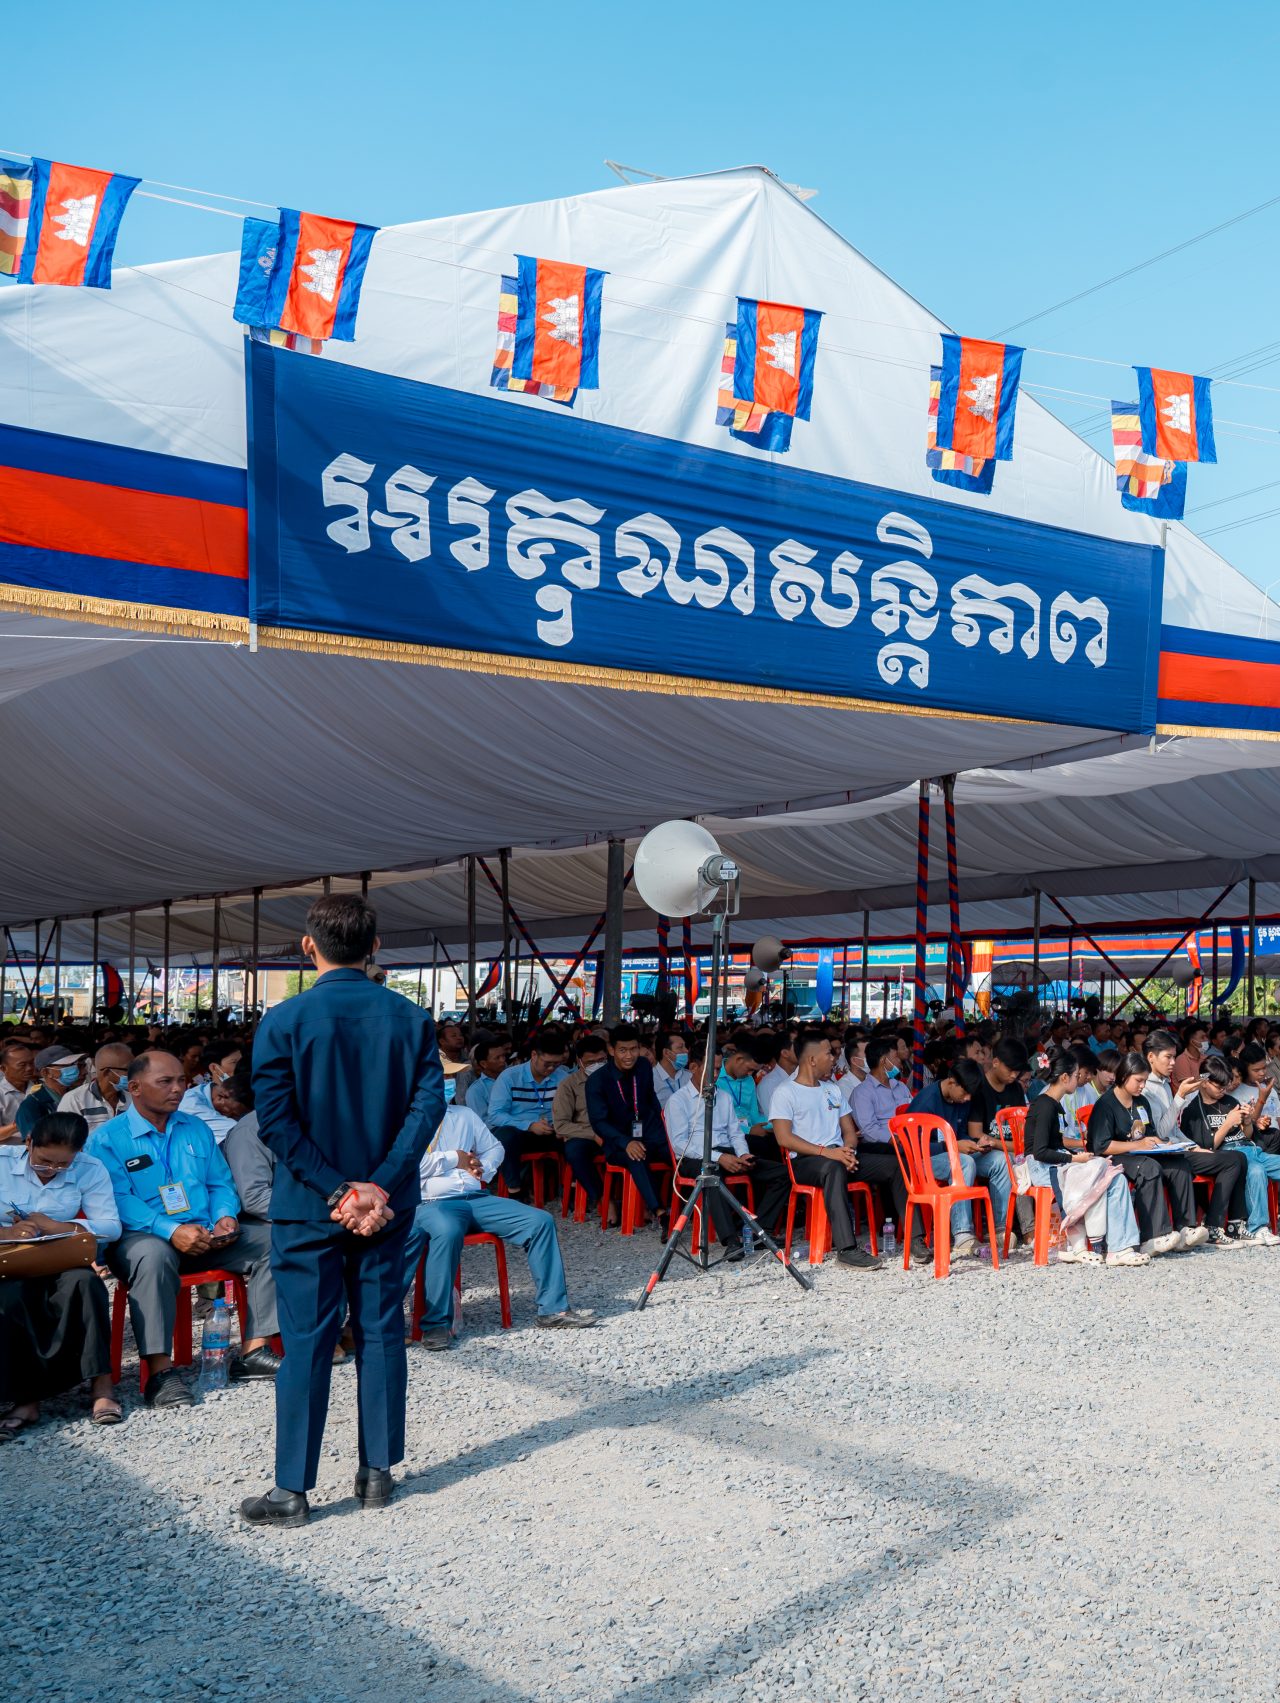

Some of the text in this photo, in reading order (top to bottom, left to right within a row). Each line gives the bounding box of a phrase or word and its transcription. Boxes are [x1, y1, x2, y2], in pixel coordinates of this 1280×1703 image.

[321, 452, 1110, 689] អរគុណសន្តិភាព
